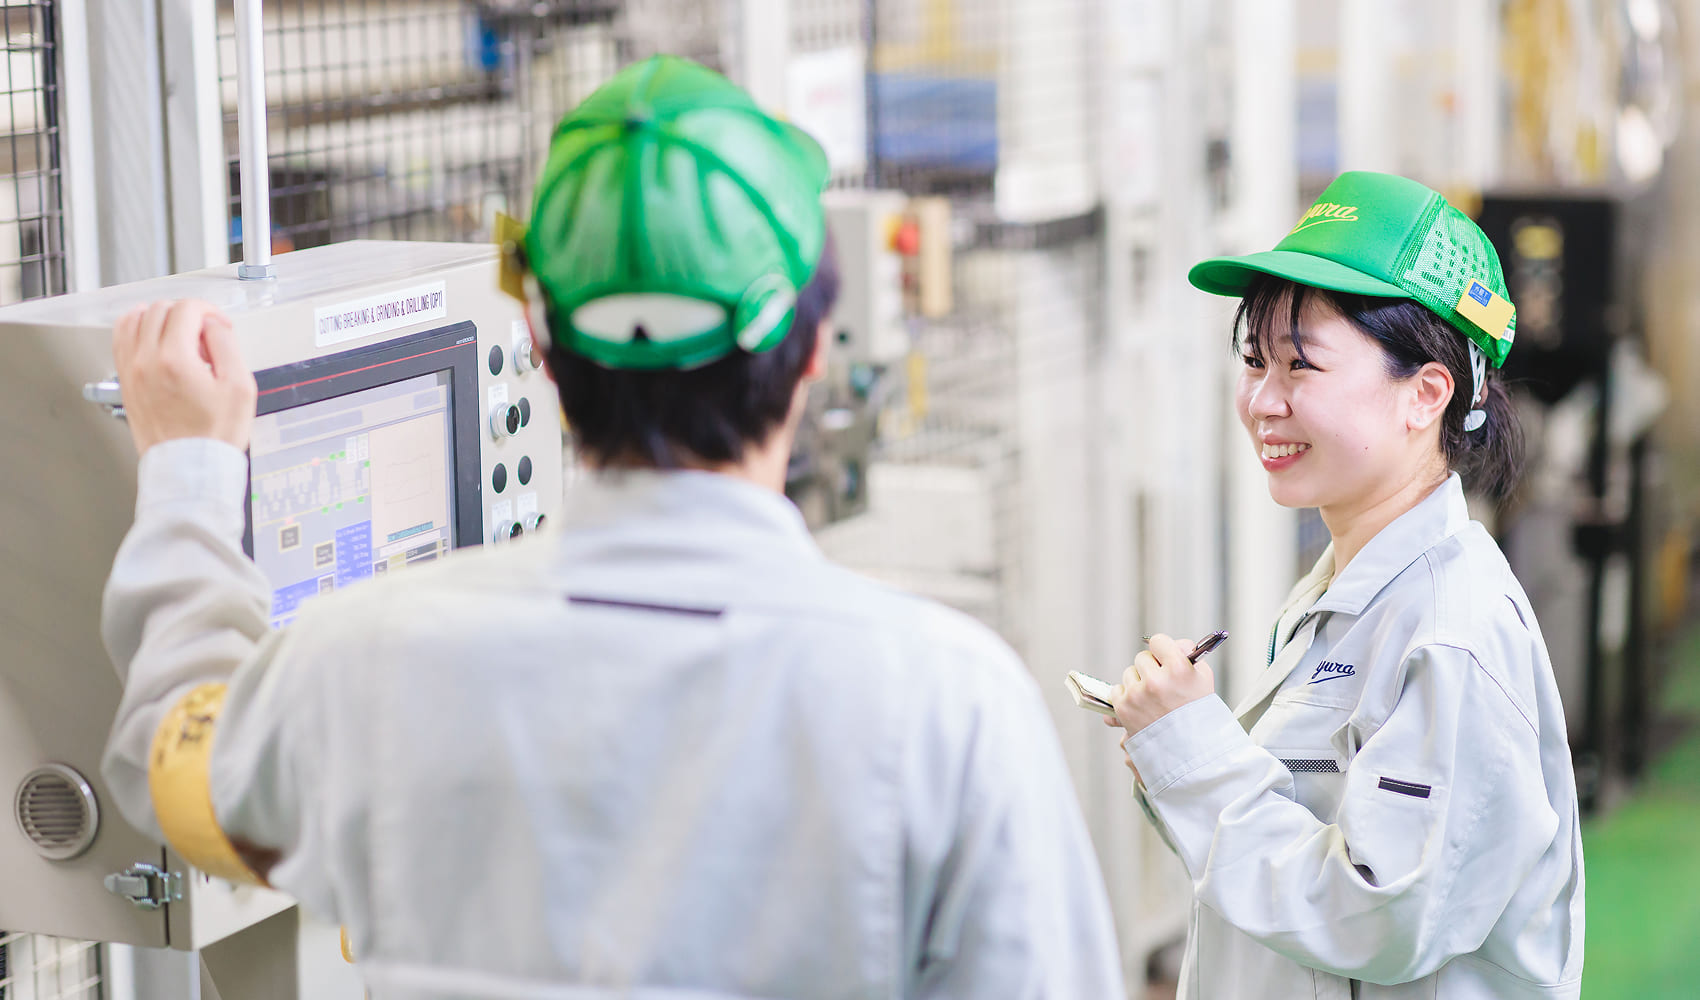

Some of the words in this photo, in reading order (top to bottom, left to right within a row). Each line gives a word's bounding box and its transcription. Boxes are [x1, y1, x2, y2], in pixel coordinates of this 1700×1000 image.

[319, 314, 343, 334] CUTTING
[343, 308, 370, 328] BREAKING
[371, 307, 376, 322] &
[376, 301, 400, 321] GRINDING
[401, 300, 406, 316] &
[406, 294, 430, 314] DRILLING
